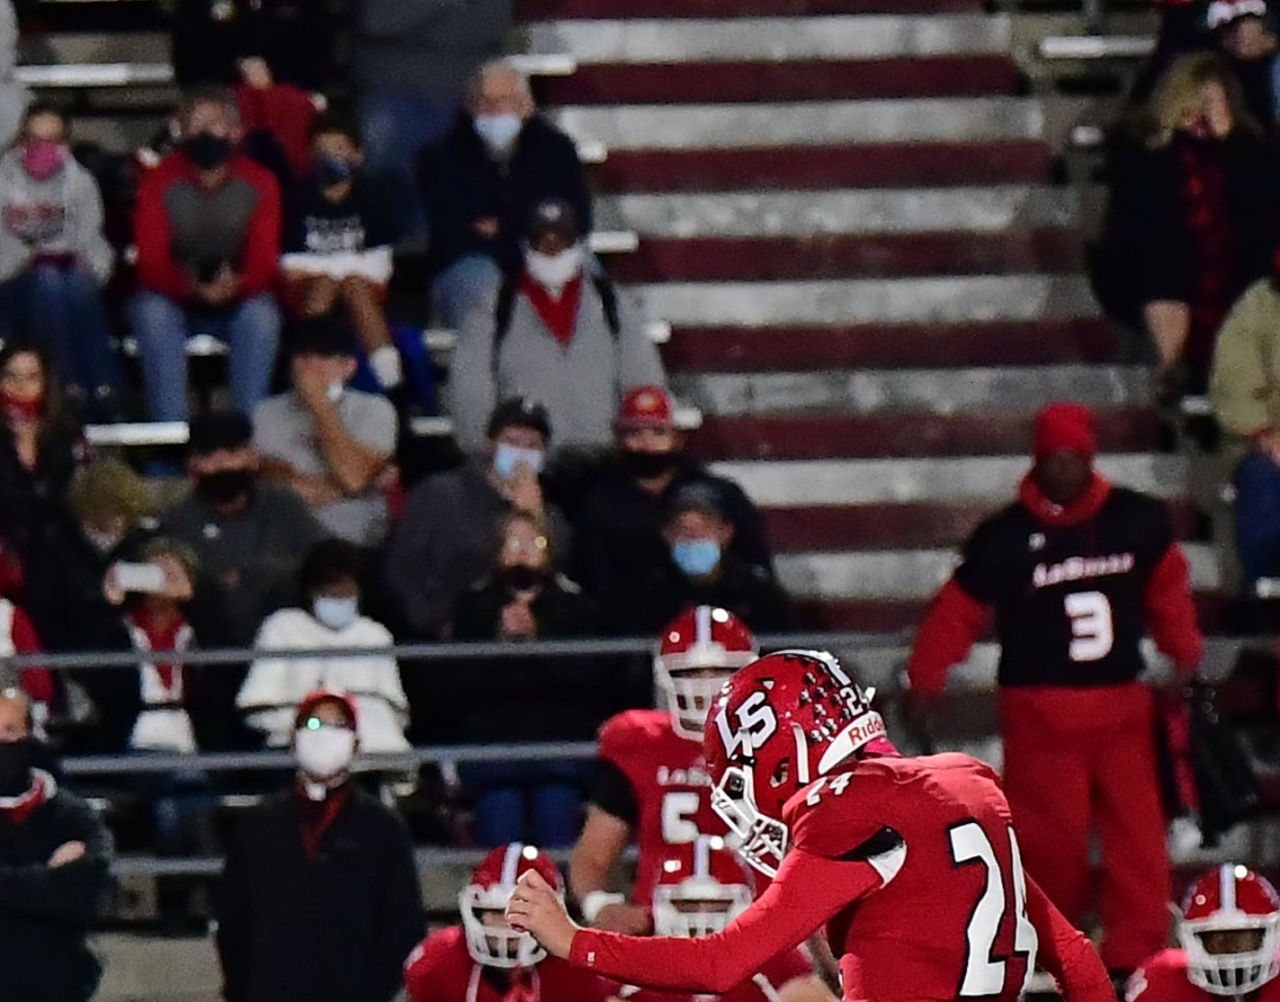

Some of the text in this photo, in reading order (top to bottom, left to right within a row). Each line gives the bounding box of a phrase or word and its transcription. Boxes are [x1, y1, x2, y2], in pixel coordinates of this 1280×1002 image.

[1063, 591, 1114, 661] 3
[715, 692, 777, 759] LS
[662, 791, 700, 844] 5
[806, 771, 855, 807] 24
[949, 821, 1039, 998] 24
